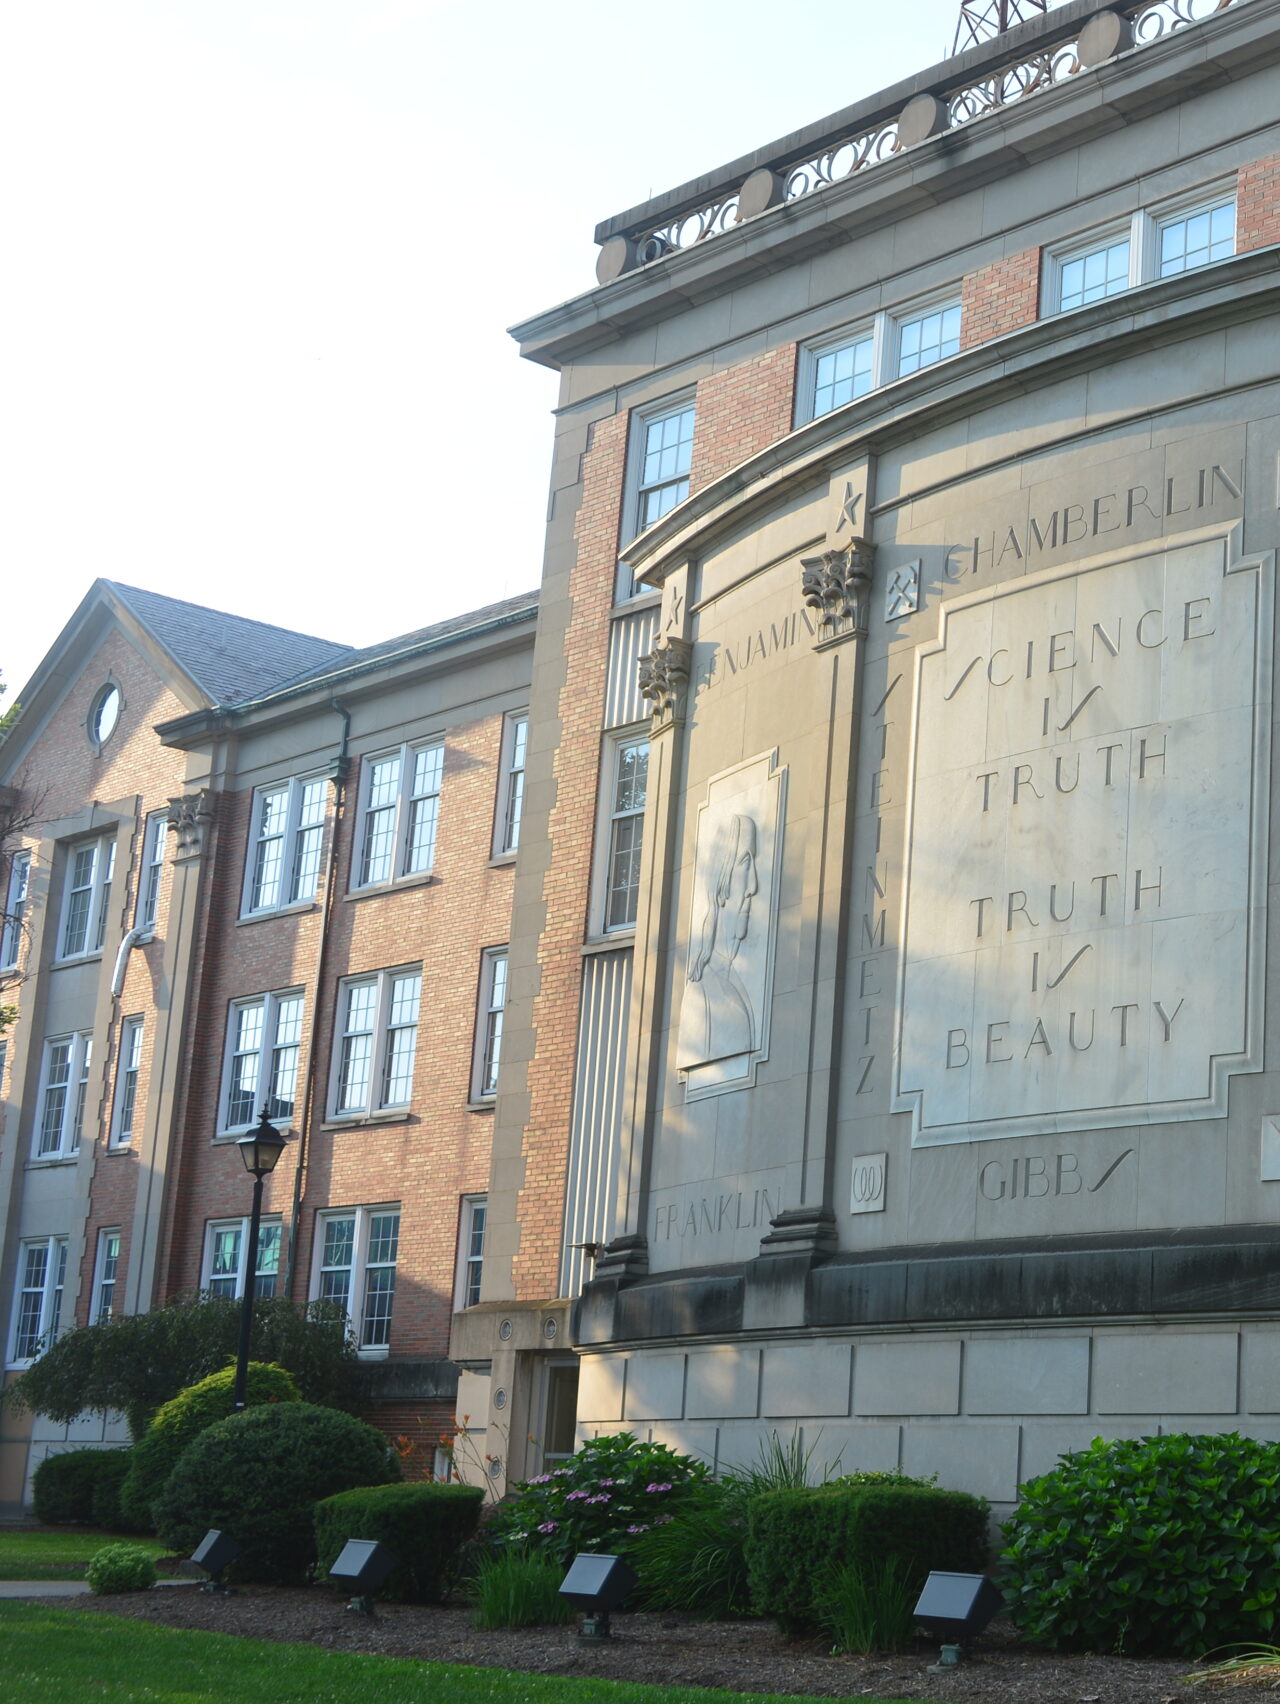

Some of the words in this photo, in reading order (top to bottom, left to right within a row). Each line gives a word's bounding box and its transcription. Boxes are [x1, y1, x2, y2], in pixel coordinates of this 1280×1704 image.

[943, 457, 1244, 580] CHAMBERLIN
[944, 596, 1217, 702] SCIENCE
[1042, 684, 1104, 738] IS
[975, 733, 1168, 813] TRUTH
[855, 672, 904, 1096] STEINMETZ
[969, 865, 1164, 940] TRUTH
[1031, 943, 1095, 994] IS
[945, 997, 1186, 1071] BEAUTY
[978, 1148, 1135, 1202] GIBBS
[654, 1186, 781, 1243] FRANKLIN
